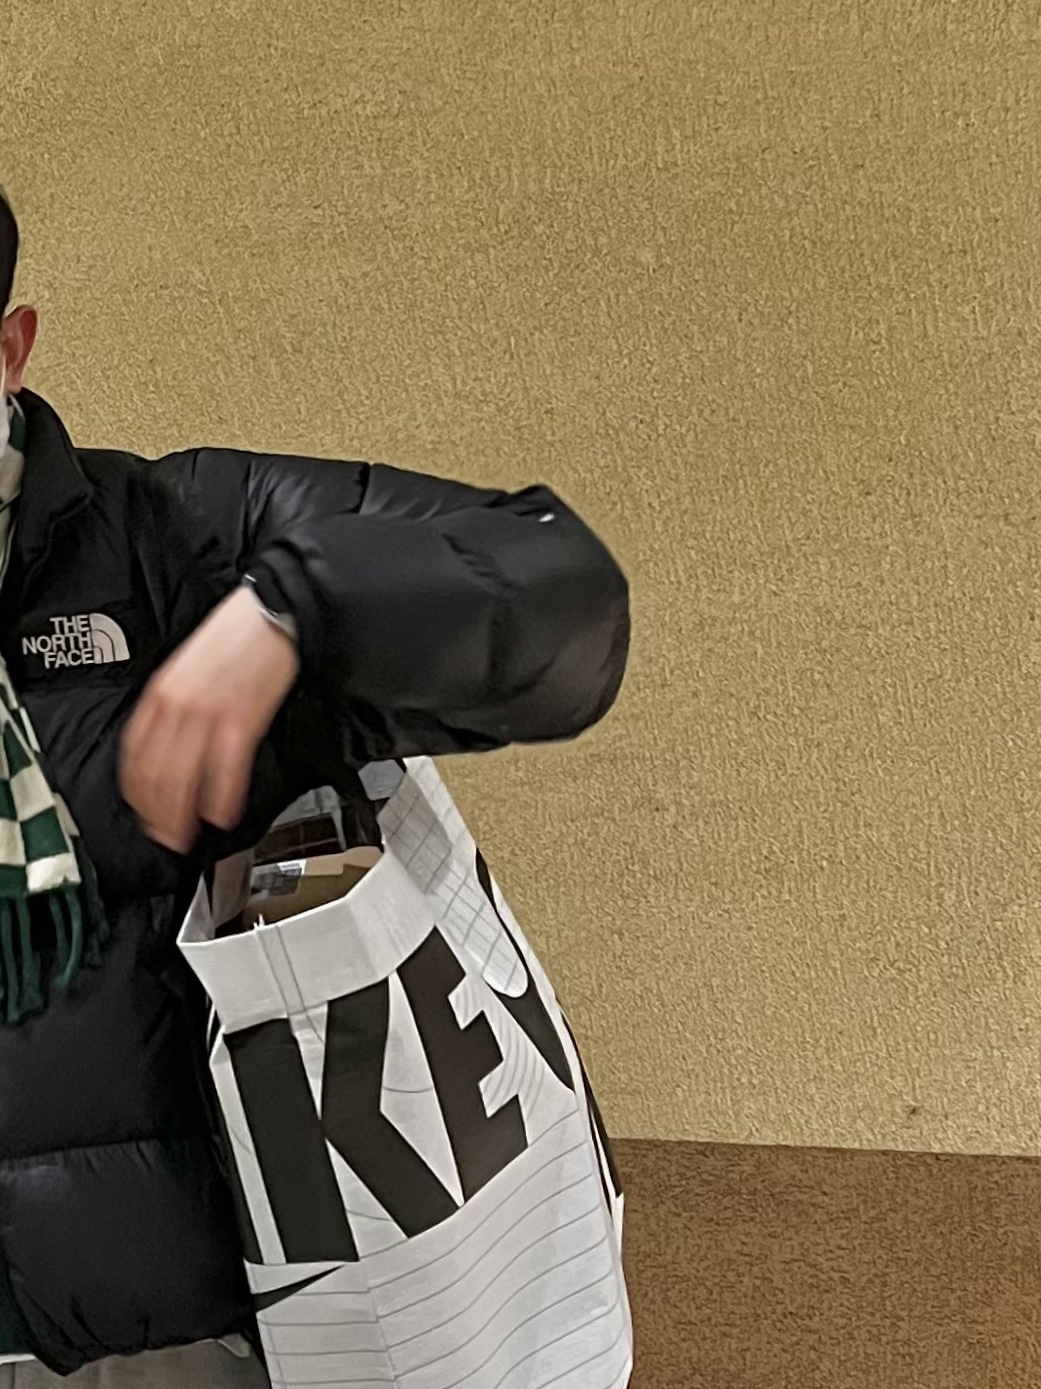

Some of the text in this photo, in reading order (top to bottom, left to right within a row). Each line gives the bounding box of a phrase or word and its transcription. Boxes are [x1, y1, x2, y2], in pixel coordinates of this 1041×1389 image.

[49, 614, 90, 635] THE
[21, 631, 92, 655] NORTH
[43, 648, 94, 669] FACE
